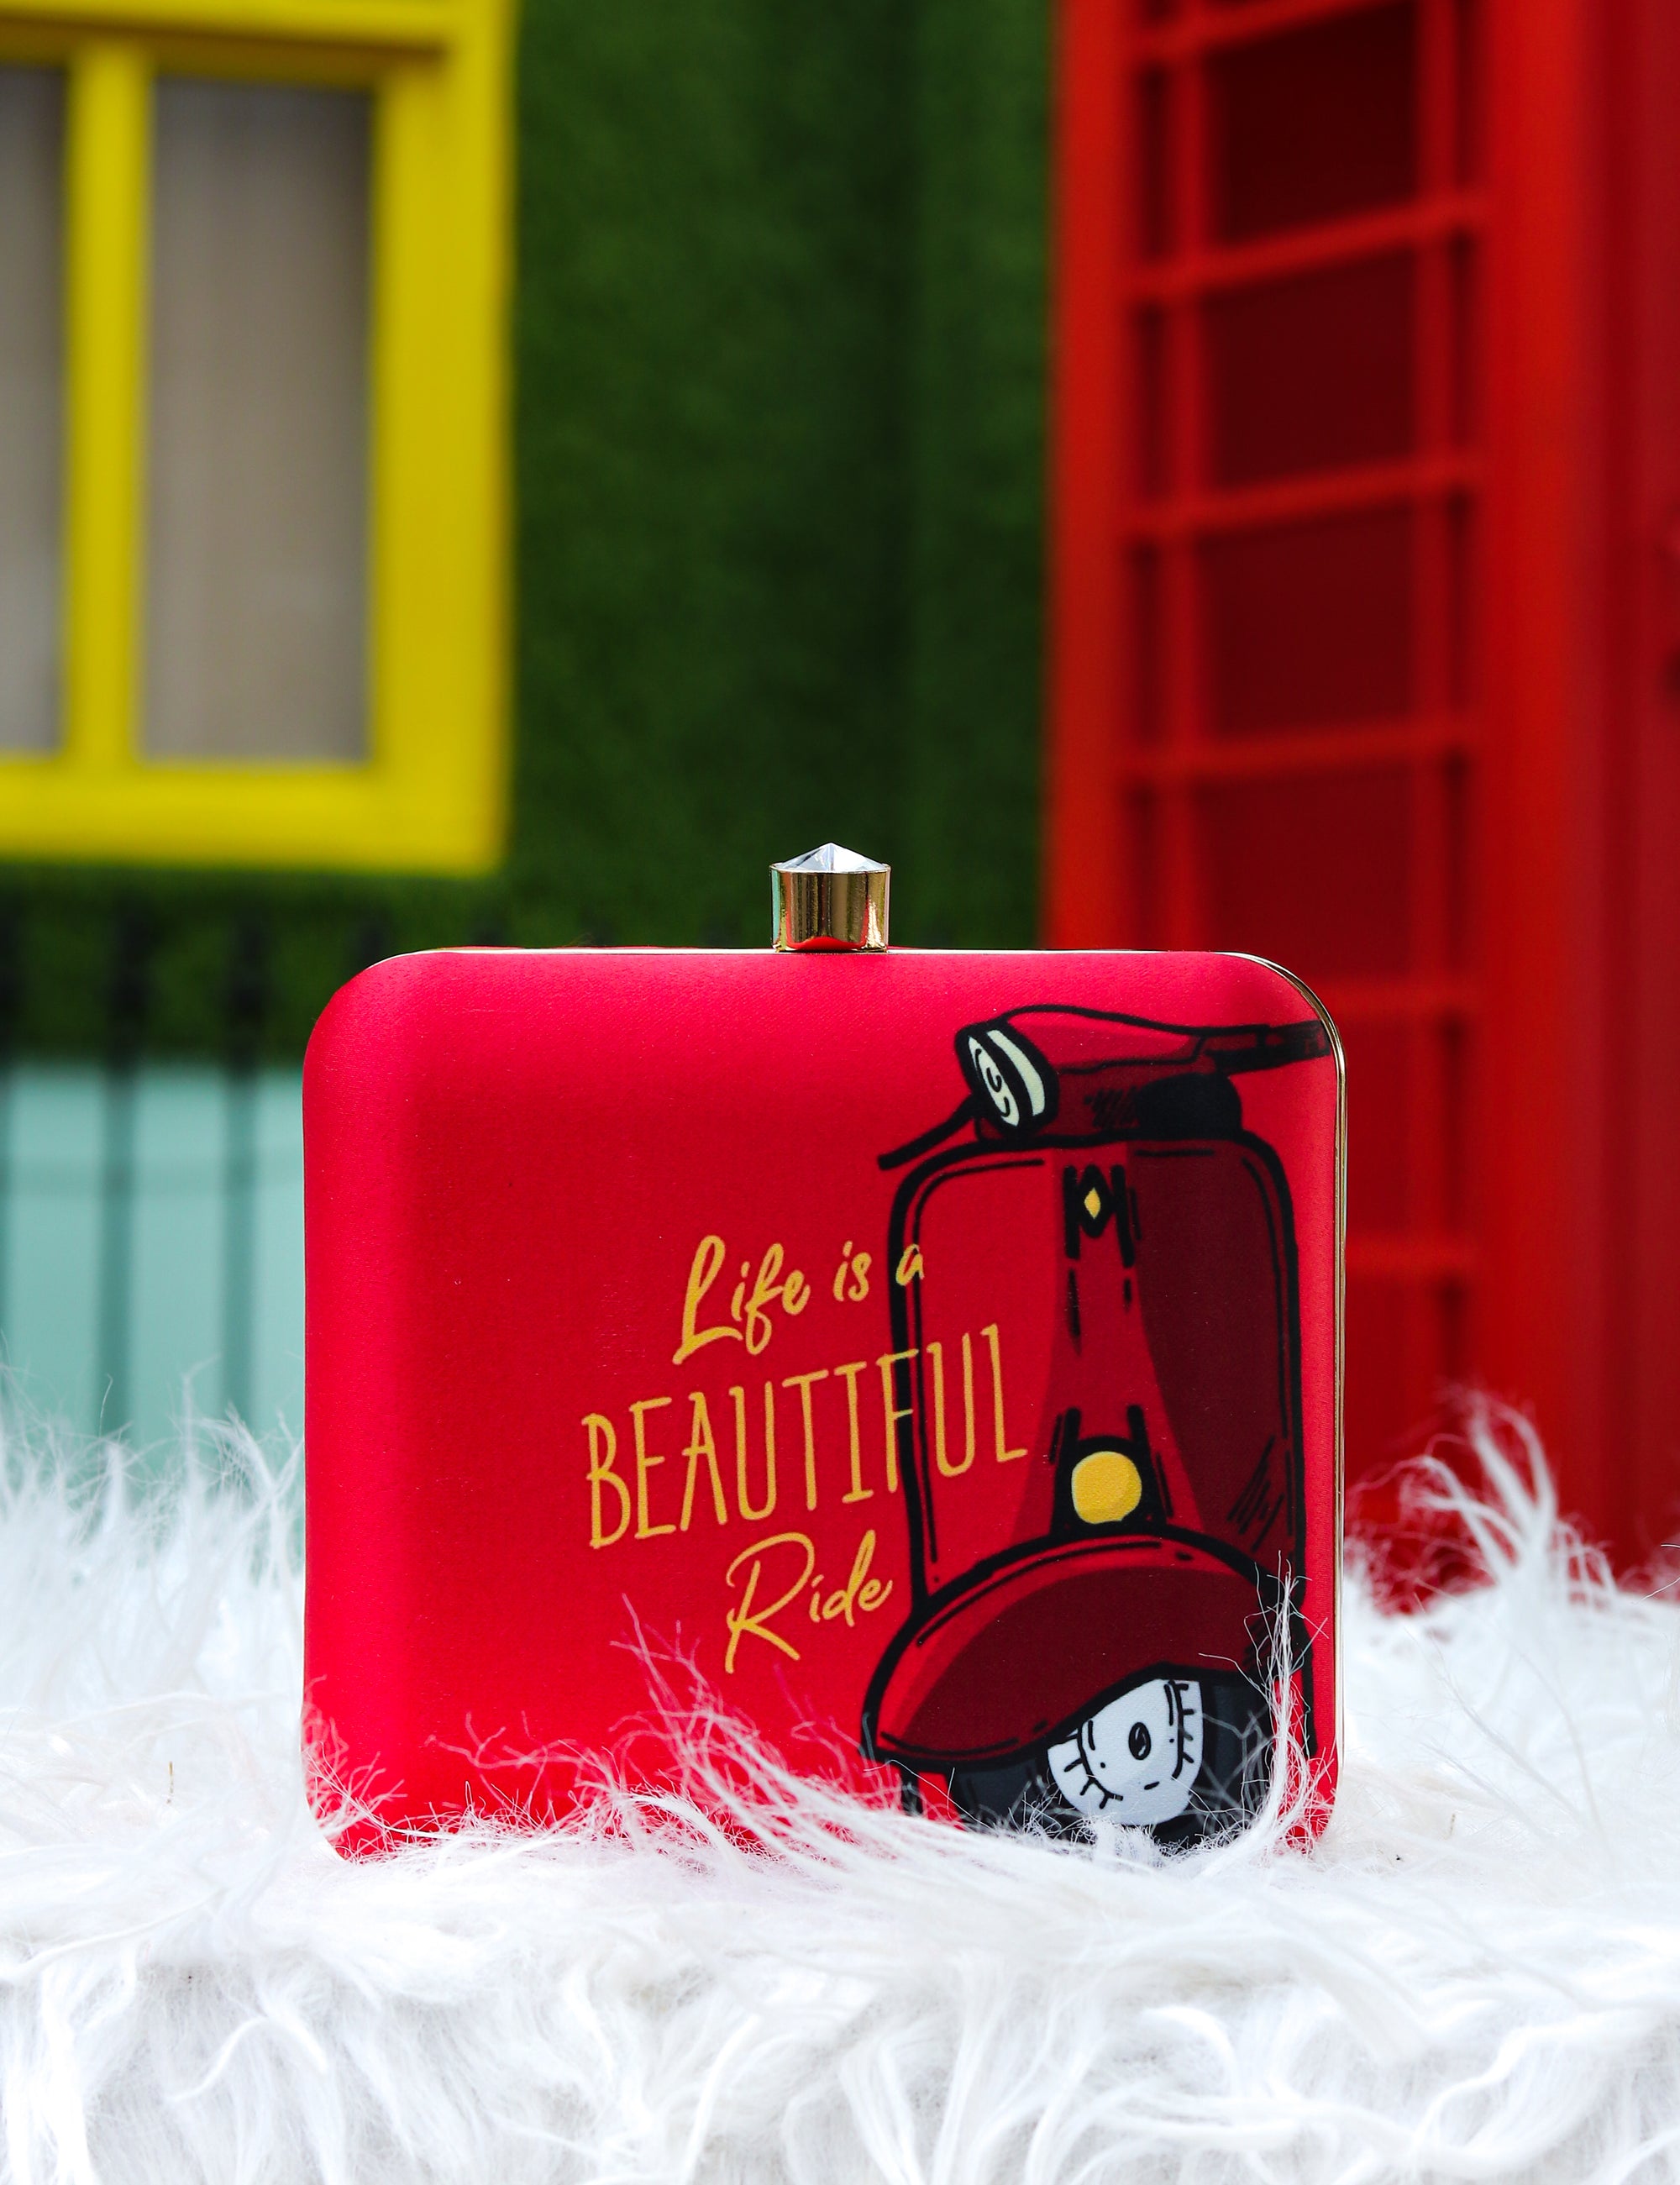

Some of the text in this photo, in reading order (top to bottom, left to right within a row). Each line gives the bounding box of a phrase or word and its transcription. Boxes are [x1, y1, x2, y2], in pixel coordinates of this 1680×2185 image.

[672, 1235, 924, 1364] Life is a
[581, 1323, 1027, 1549] BEAUTIFUL
[725, 1530, 893, 1674] Ride
